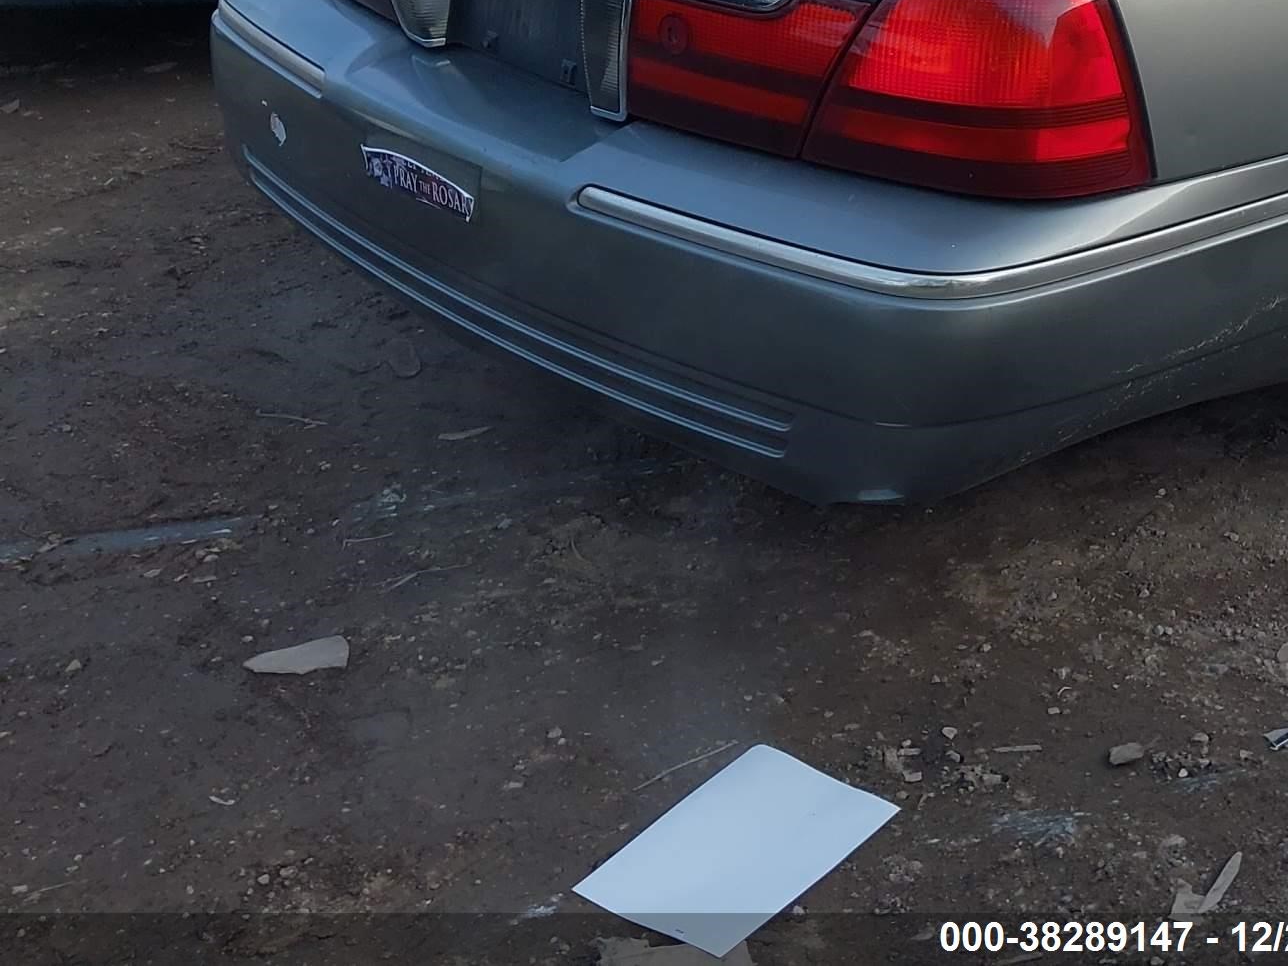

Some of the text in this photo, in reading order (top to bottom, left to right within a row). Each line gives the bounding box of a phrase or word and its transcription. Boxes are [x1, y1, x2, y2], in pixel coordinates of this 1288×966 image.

[393, 164, 418, 194] PRAY
[419, 180, 431, 195] THE
[431, 181, 475, 217] ROSARY
